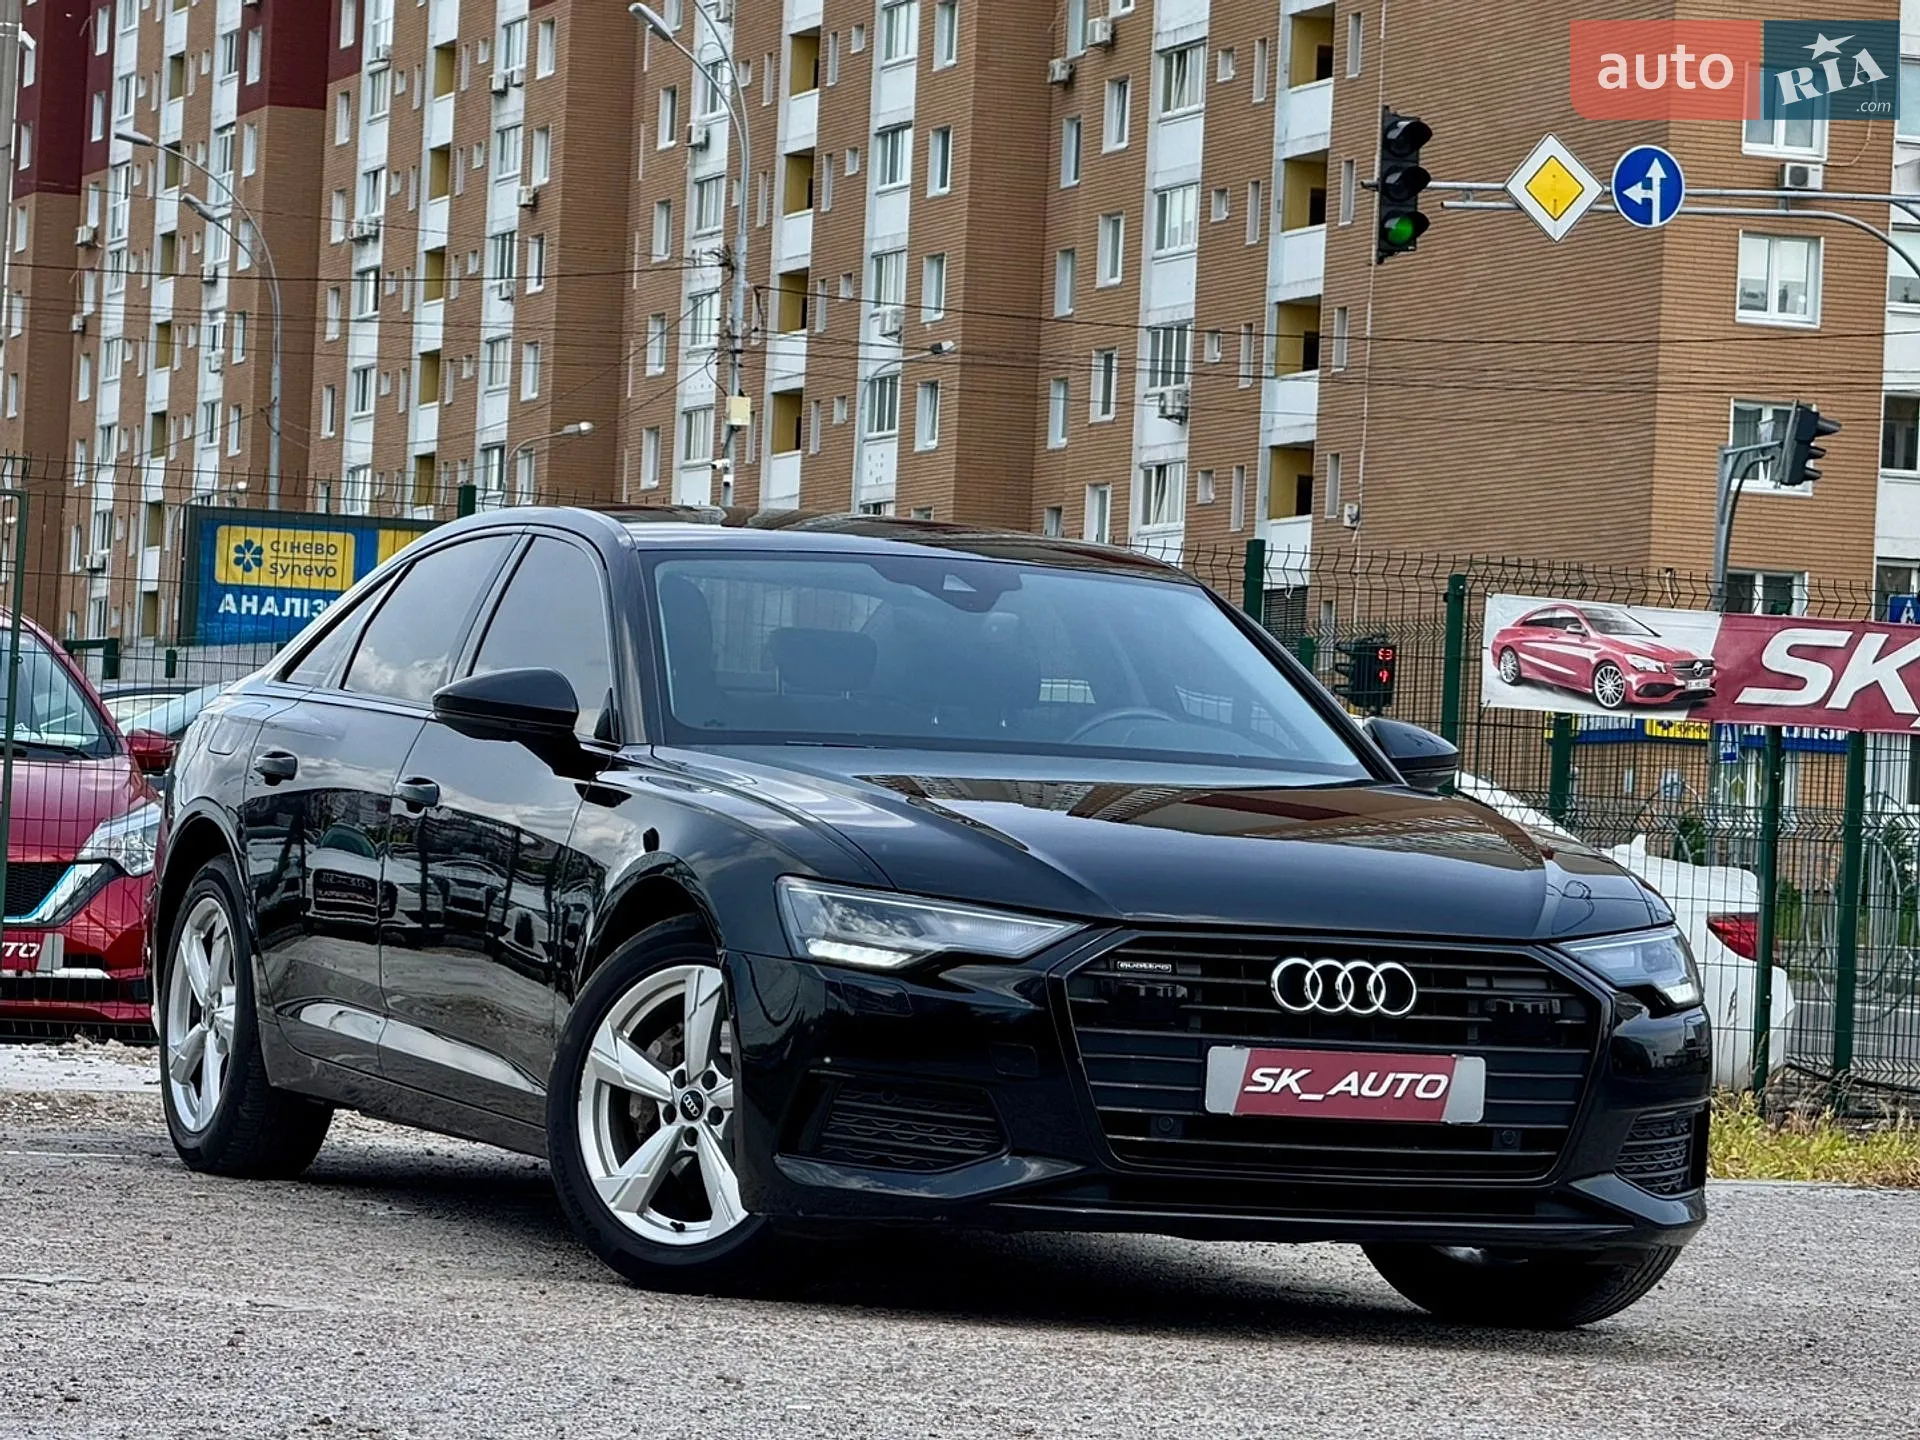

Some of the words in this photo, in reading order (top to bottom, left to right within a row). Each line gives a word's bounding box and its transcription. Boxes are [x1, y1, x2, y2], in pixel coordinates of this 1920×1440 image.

[268, 563, 338, 580] synevo
[217, 593, 336, 619] АНАЛІЗ
[1734, 627, 1920, 728] SK
[1243, 1066, 1450, 1101] SK_AUTO
